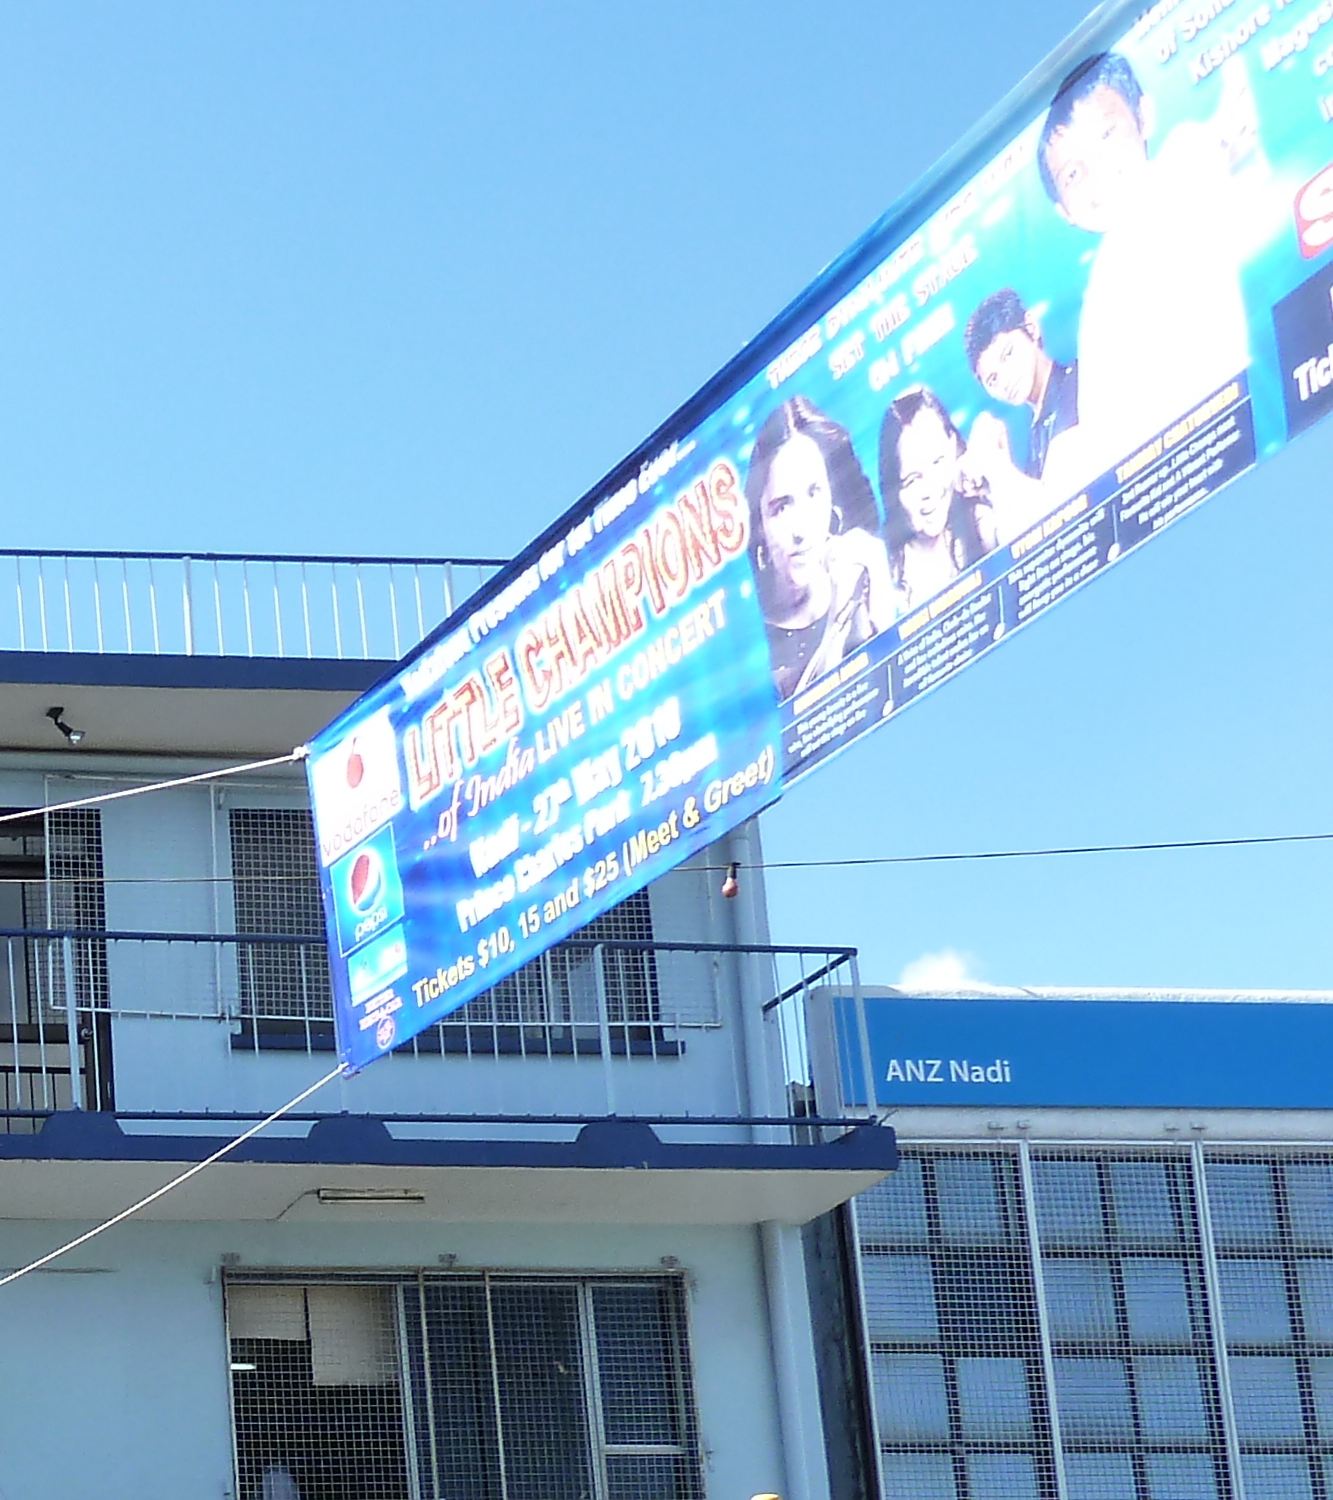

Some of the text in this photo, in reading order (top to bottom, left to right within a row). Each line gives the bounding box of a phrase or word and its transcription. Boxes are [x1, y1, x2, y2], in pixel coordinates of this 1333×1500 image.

[1189, 6, 1272, 85] Kishore
[407, 652, 521, 800] LITTLE
[518, 461, 745, 709] CHAMPIONS
[468, 739, 533, 816] India
[535, 701, 586, 763] LIVE
[586, 681, 615, 725] IN
[617, 589, 727, 699] CONCERT
[572, 744, 622, 801] May
[622, 696, 682, 771] 2010
[323, 789, 400, 857] vodafone
[412, 954, 475, 1007] Tickets
[477, 930, 516, 969] $10,
[518, 903, 541, 939] 15
[543, 884, 581, 925] and
[583, 856, 620, 901] $25
[623, 816, 681, 877] (Meet
[682, 801, 701, 830] &
[704, 744, 776, 816] Greet)
[456, 873, 516, 932] Prince
[516, 823, 585, 893] Charles
[584, 793, 631, 848] Park
[355, 906, 389, 942] pepsi
[886, 1058, 1012, 1084] ANZ Nadi
